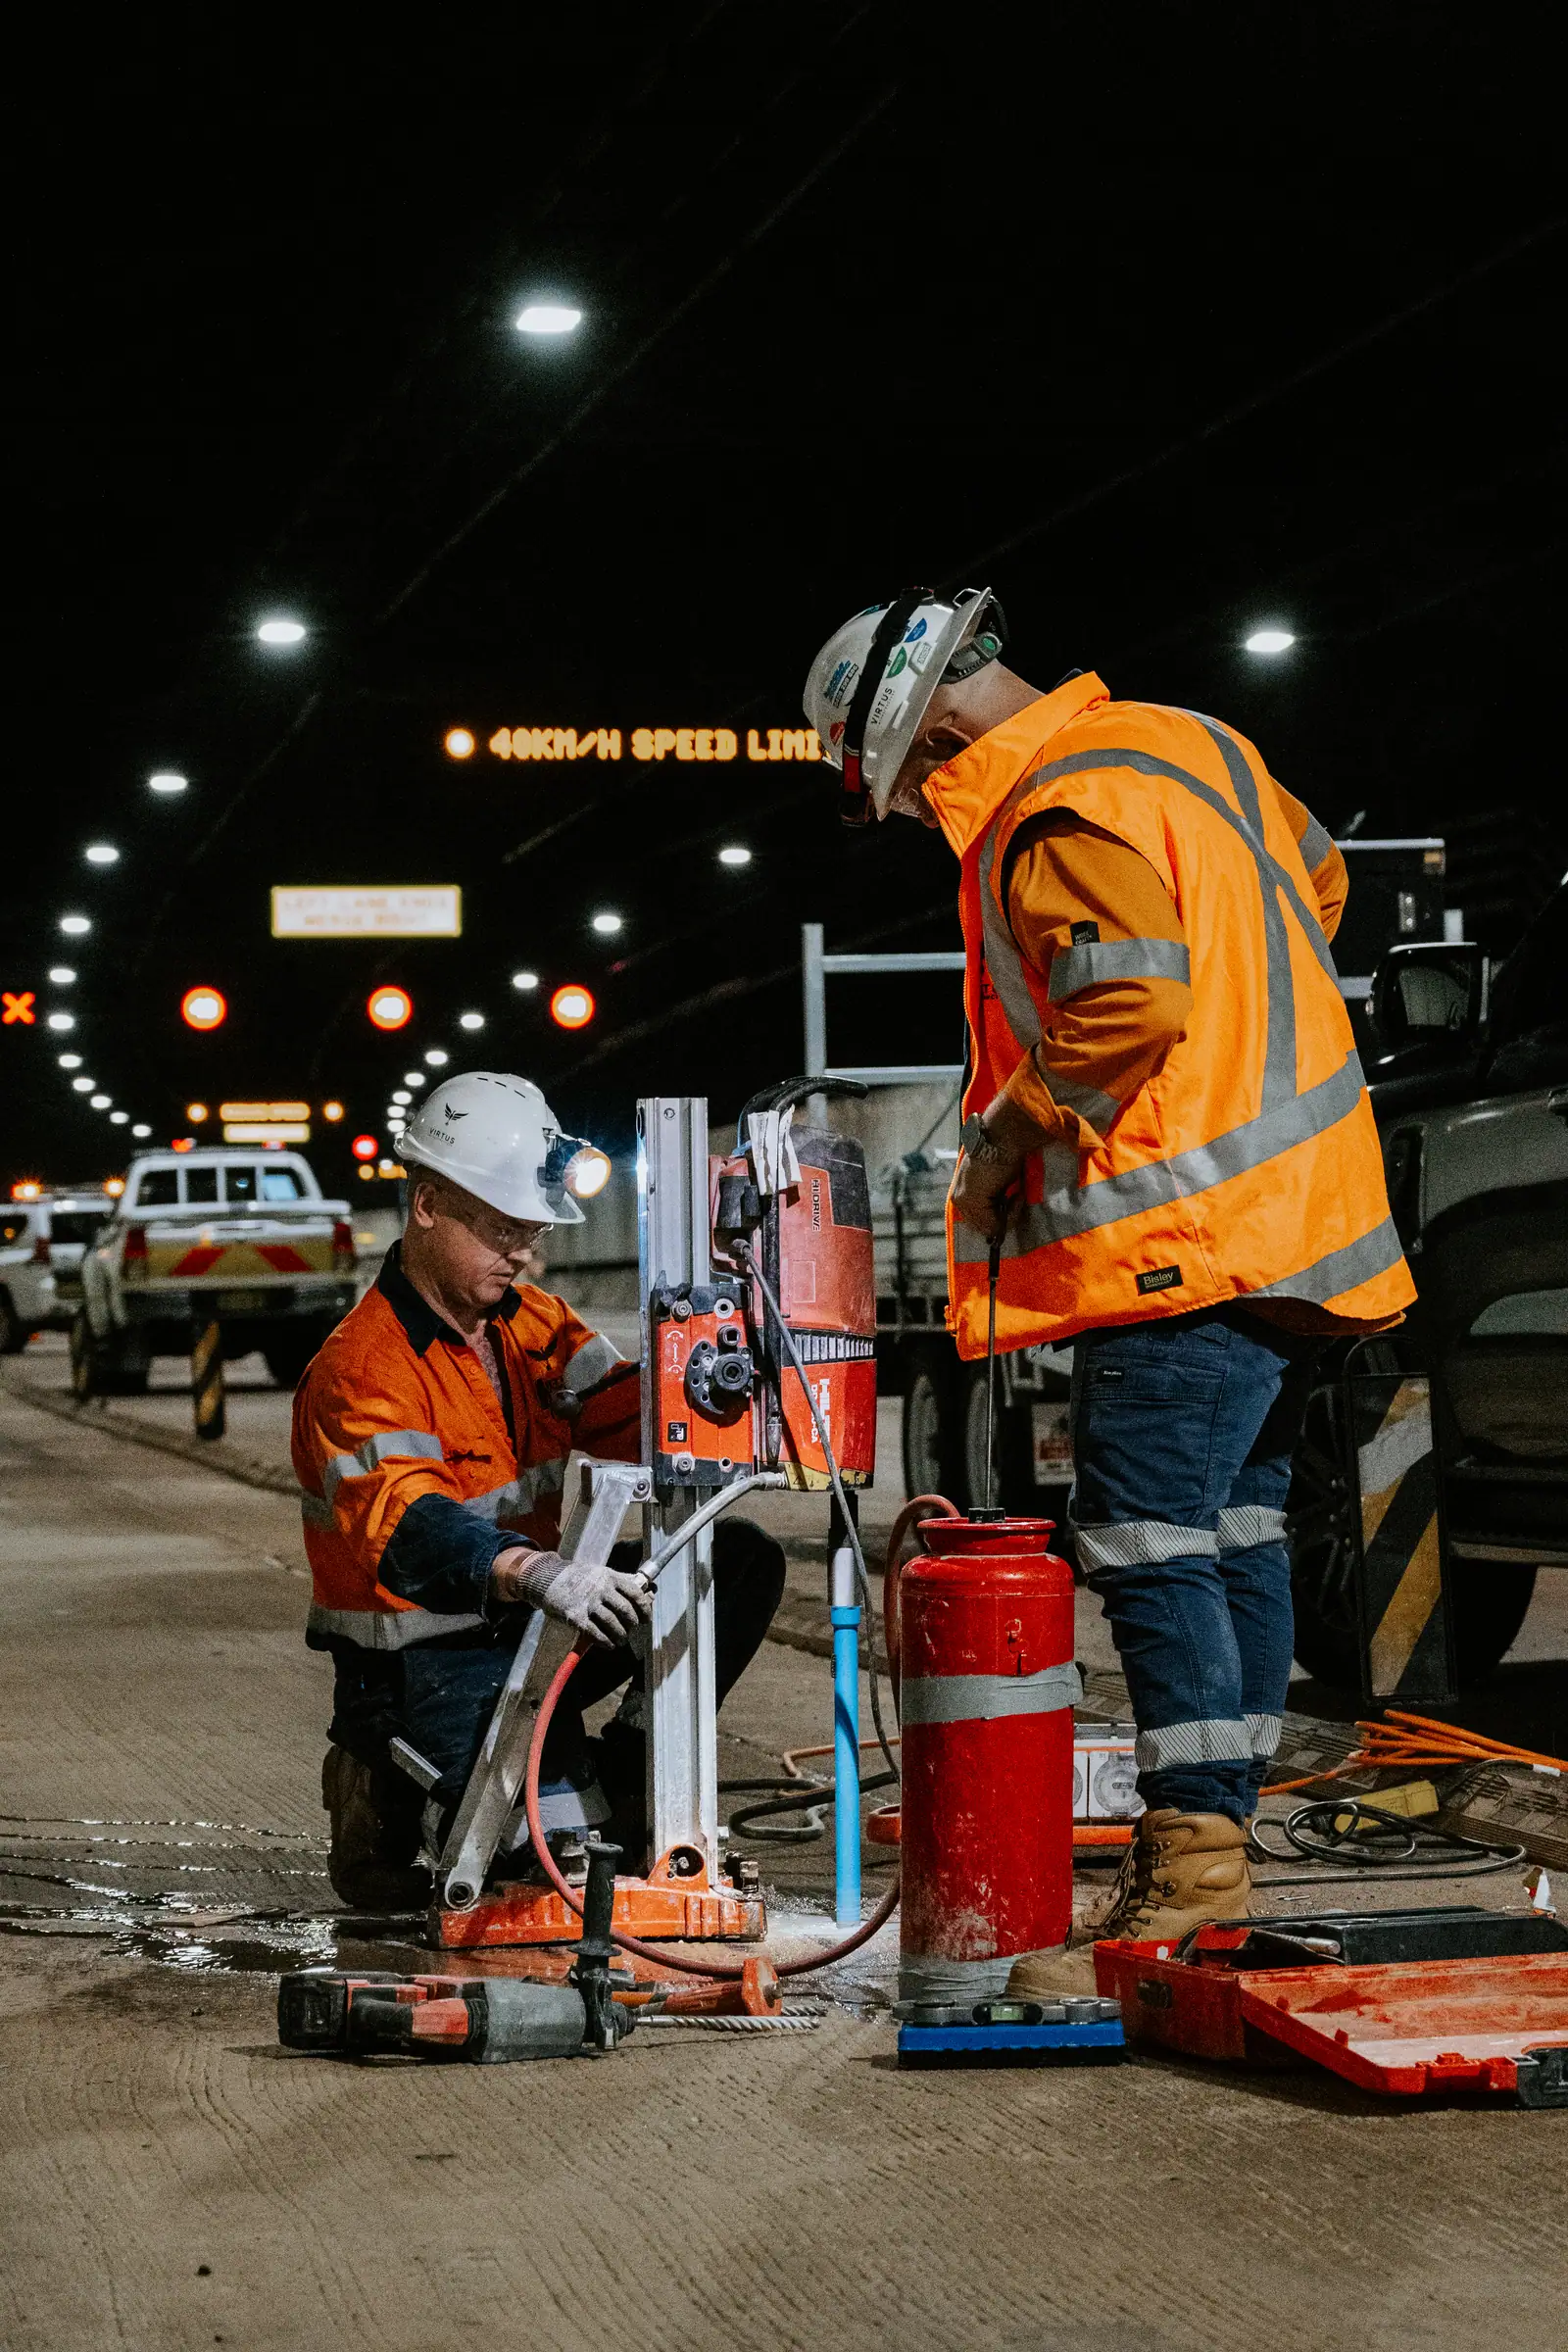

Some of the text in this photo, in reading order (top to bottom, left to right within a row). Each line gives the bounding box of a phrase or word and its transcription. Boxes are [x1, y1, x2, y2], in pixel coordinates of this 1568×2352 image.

[871, 687, 893, 725] VIRTUS
[490, 727, 830, 760] 40KM/H SPEED LIMI
[429, 1128, 456, 1144] VIRTUS
[1144, 1272, 1174, 1285] Bisley
